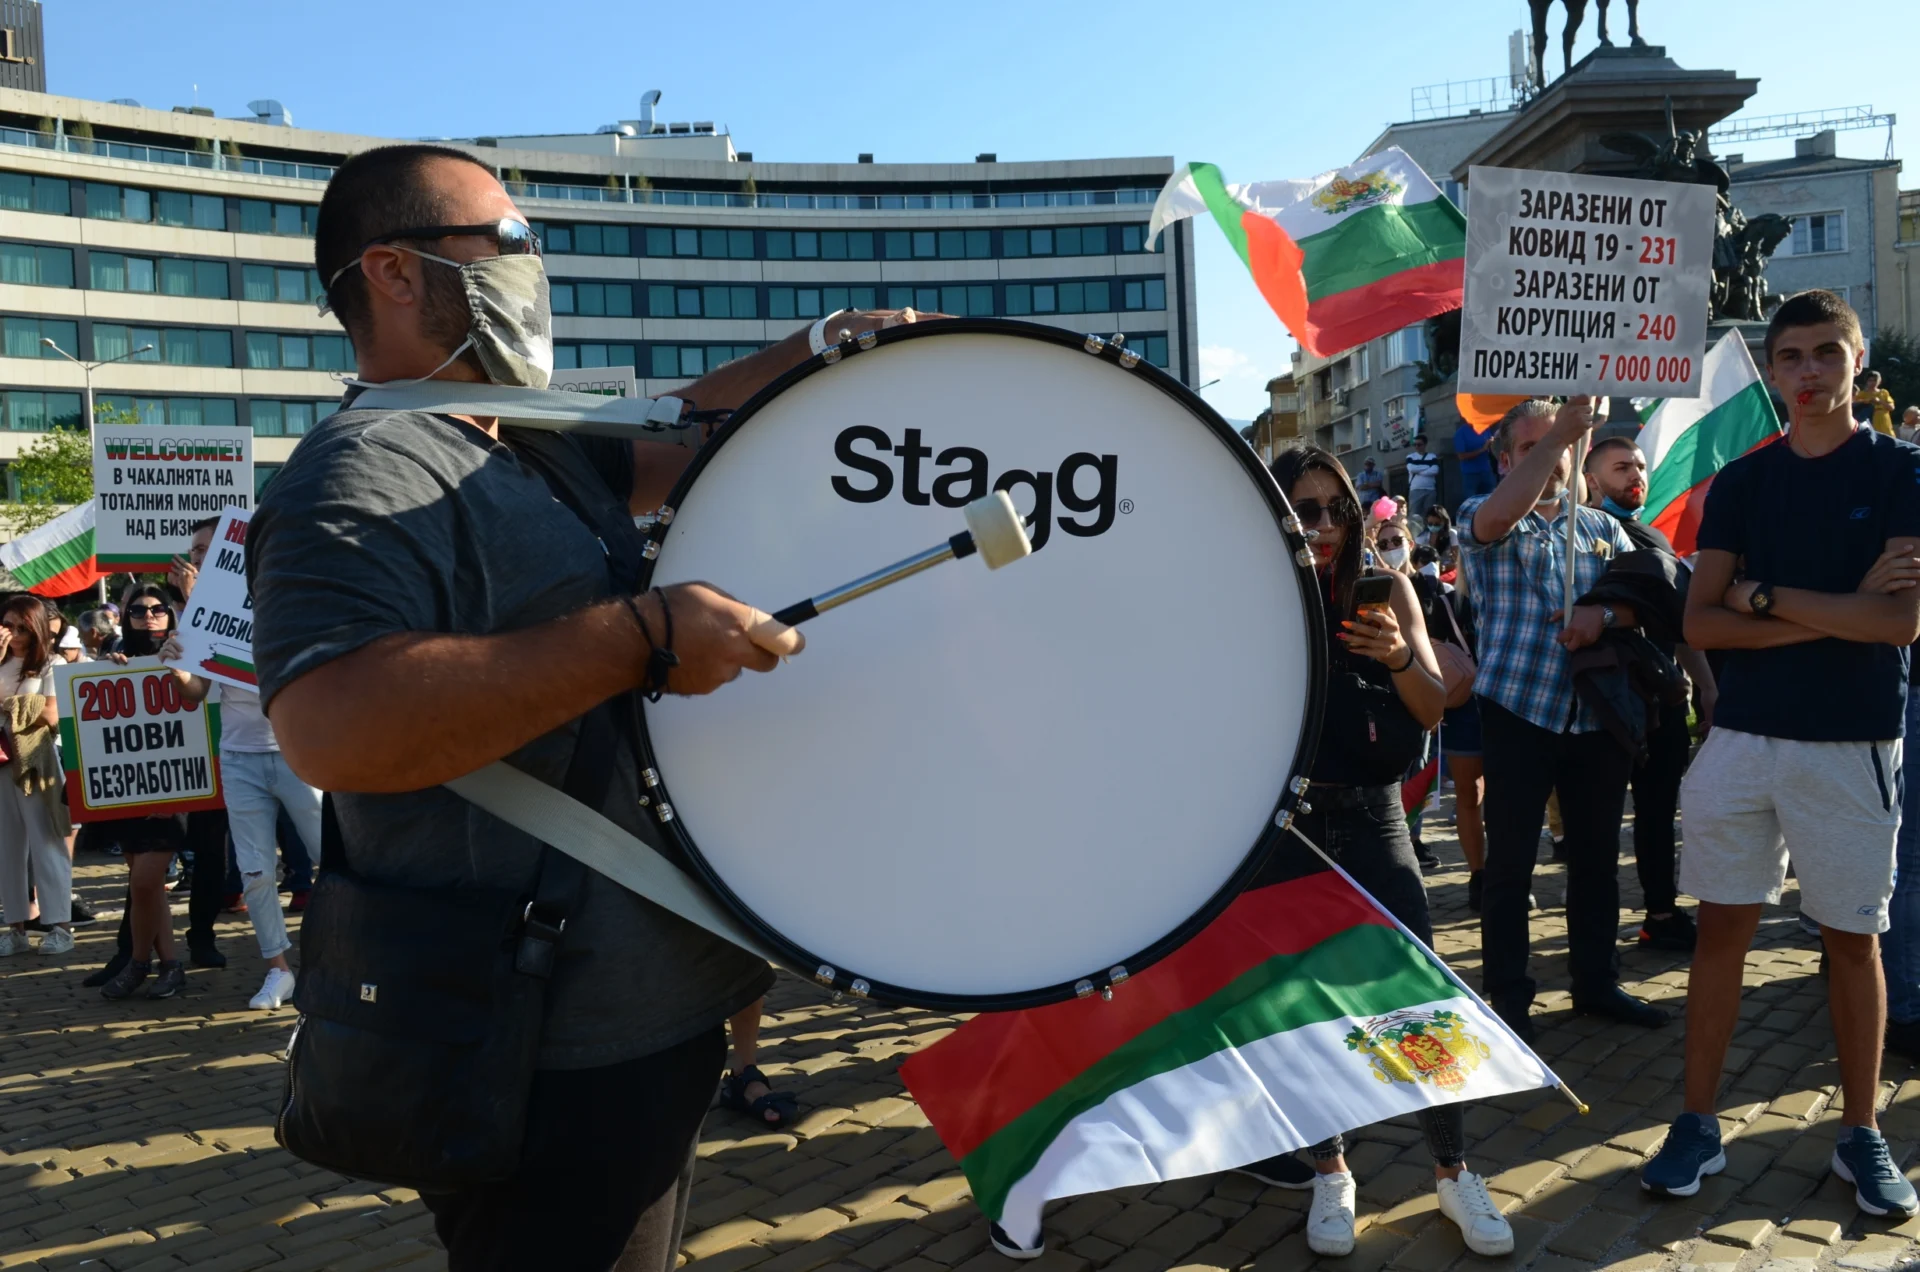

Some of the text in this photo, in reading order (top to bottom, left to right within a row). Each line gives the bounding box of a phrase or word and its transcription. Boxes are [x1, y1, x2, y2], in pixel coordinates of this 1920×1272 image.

[0, 28, 24, 62] L
[1519, 188, 1667, 227] ЗАРАЗЕНИ ОТ
[1508, 226, 1586, 265] КОВИД
[1594, 233, 1619, 261] 19
[1639, 236, 1676, 265] 231
[1513, 269, 1660, 304] ЗАРАЗЕНИ ОТ
[1497, 306, 1616, 343] КОРУПЦИЯ
[1636, 313, 1676, 341] 240
[1473, 349, 1579, 380] ПОРАЗЕНИ
[1598, 354, 1610, 381] 7
[1615, 354, 1650, 382] 000
[1656, 356, 1691, 383] 000
[104, 437, 243, 462] WELCOME!
[113, 467, 234, 486] В ЧАКАЛНЯТА НА
[831, 425, 1118, 554] Stagg
[99, 493, 173, 511] ТОТАЛНИЯ
[126, 519, 198, 540] НАД БИЗН
[191, 606, 206, 628] С
[79, 673, 199, 722] 200 00
[102, 720, 185, 754] НОВИ
[88, 756, 208, 800] БЕЗРАБОТНИ
